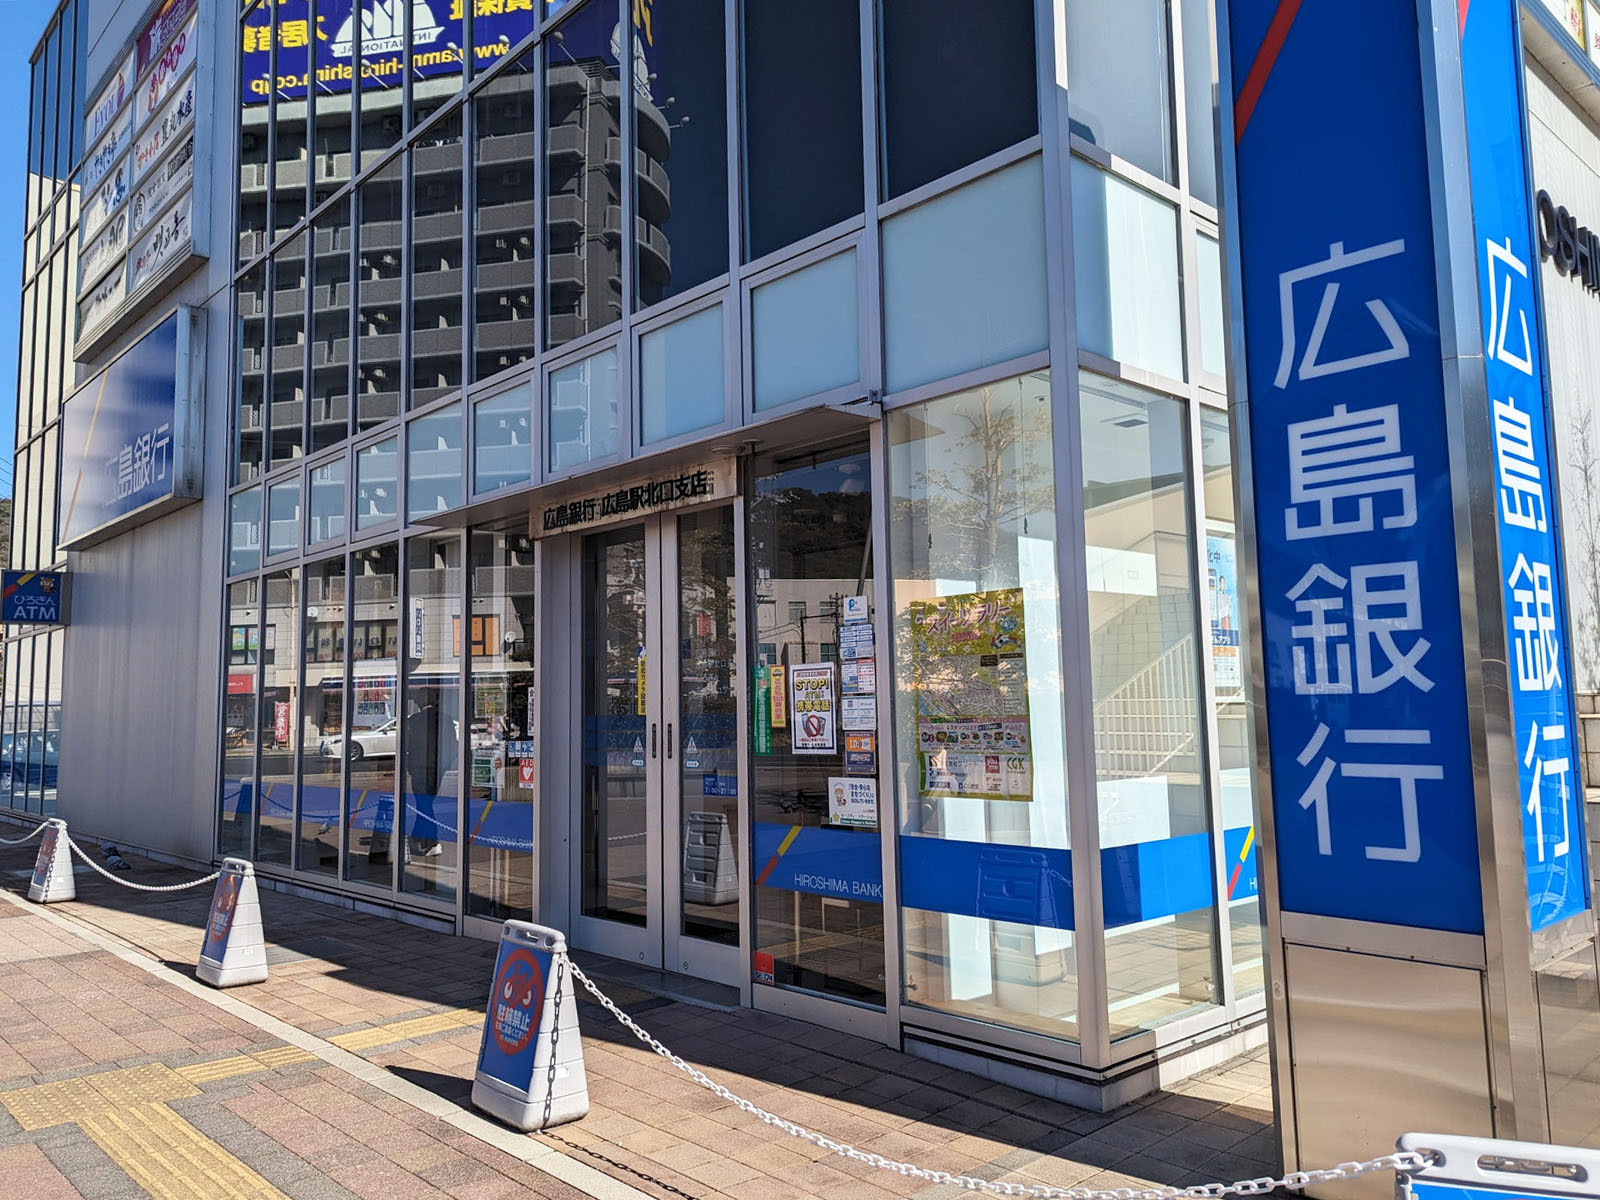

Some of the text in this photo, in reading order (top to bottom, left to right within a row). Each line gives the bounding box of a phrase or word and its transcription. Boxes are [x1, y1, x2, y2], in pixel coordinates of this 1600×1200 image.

[543, 470, 708, 531] 広島銀行 広島駅北口支店
[1273, 238, 1444, 863] 広島銀行
[1486, 236, 1570, 863] 広島銀行
[13, 606, 56, 620] ATM
[796, 678, 829, 691] STOP!
[796, 700, 830, 712] 携帯電話
[794, 873, 883, 898] HIROSHIMA BANK
[497, 1003, 530, 1032] 駐輪禁止
